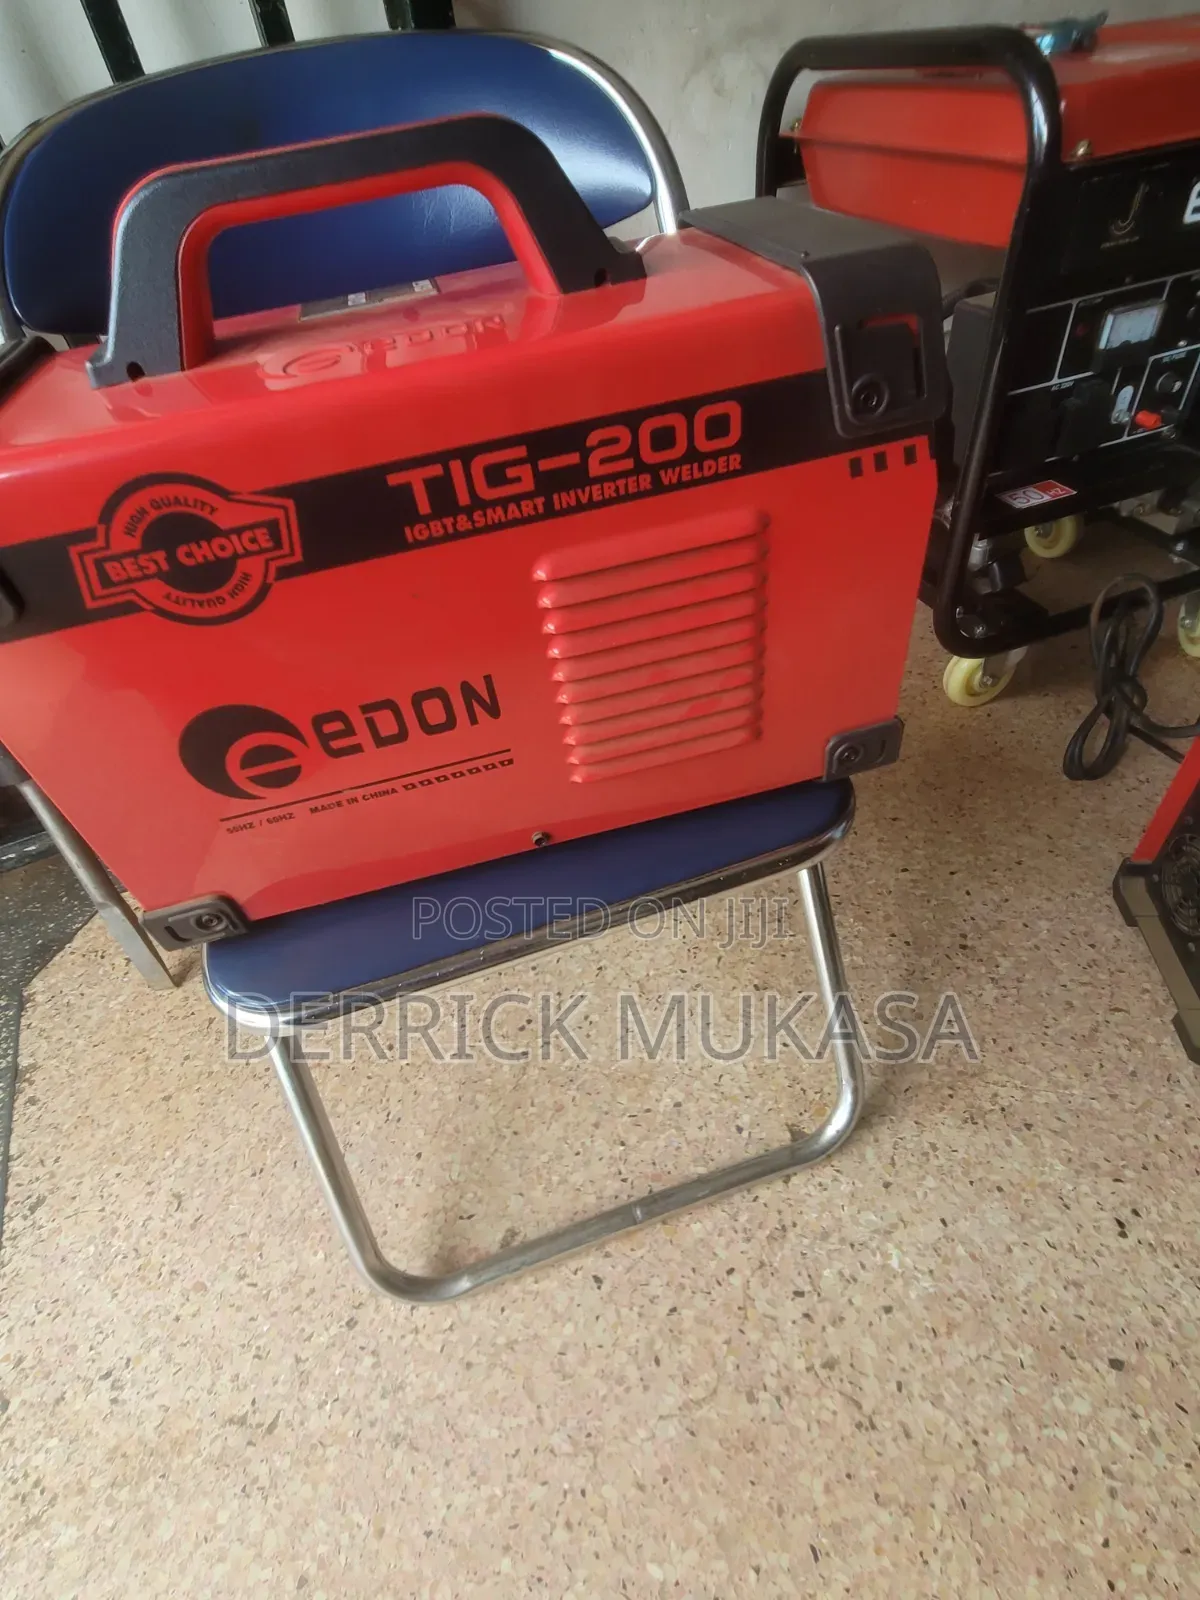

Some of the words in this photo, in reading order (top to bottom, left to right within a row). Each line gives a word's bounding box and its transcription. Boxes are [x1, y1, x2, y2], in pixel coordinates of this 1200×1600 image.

[386, 400, 742, 516] TIG-200
[149, 495, 218, 515] QUALITY
[404, 496, 545, 543] IGBT&SMART
[552, 473, 652, 511] INVERTER
[659, 453, 742, 486] WELDER
[1008, 489, 1045, 504] 50
[103, 551, 169, 582] BEST
[176, 528, 273, 566] CHOICE
[309, 799, 345, 815] MADE
[346, 797, 360, 806] IN
[362, 786, 399, 802] CHINA
